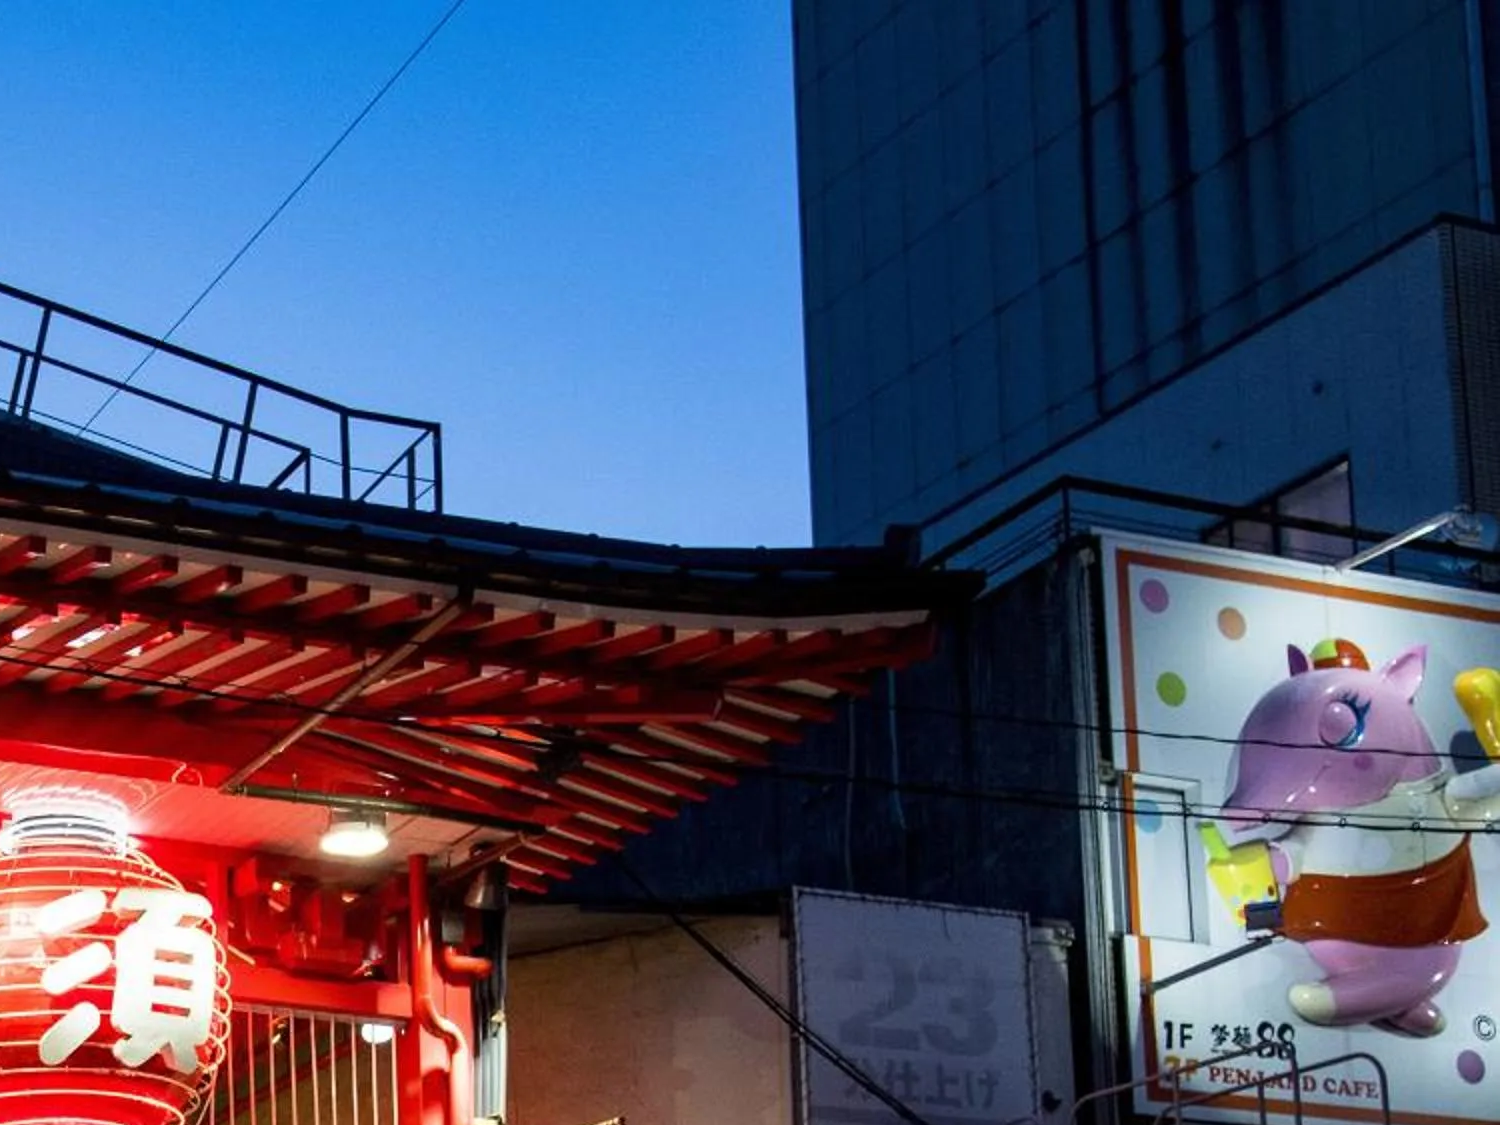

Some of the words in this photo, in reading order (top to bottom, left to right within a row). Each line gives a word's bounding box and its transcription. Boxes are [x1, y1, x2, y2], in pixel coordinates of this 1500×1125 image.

[36, 887, 216, 1076] 須
[1163, 1020, 1194, 1049] 1F
[1322, 1077, 1380, 1100] CAFE
